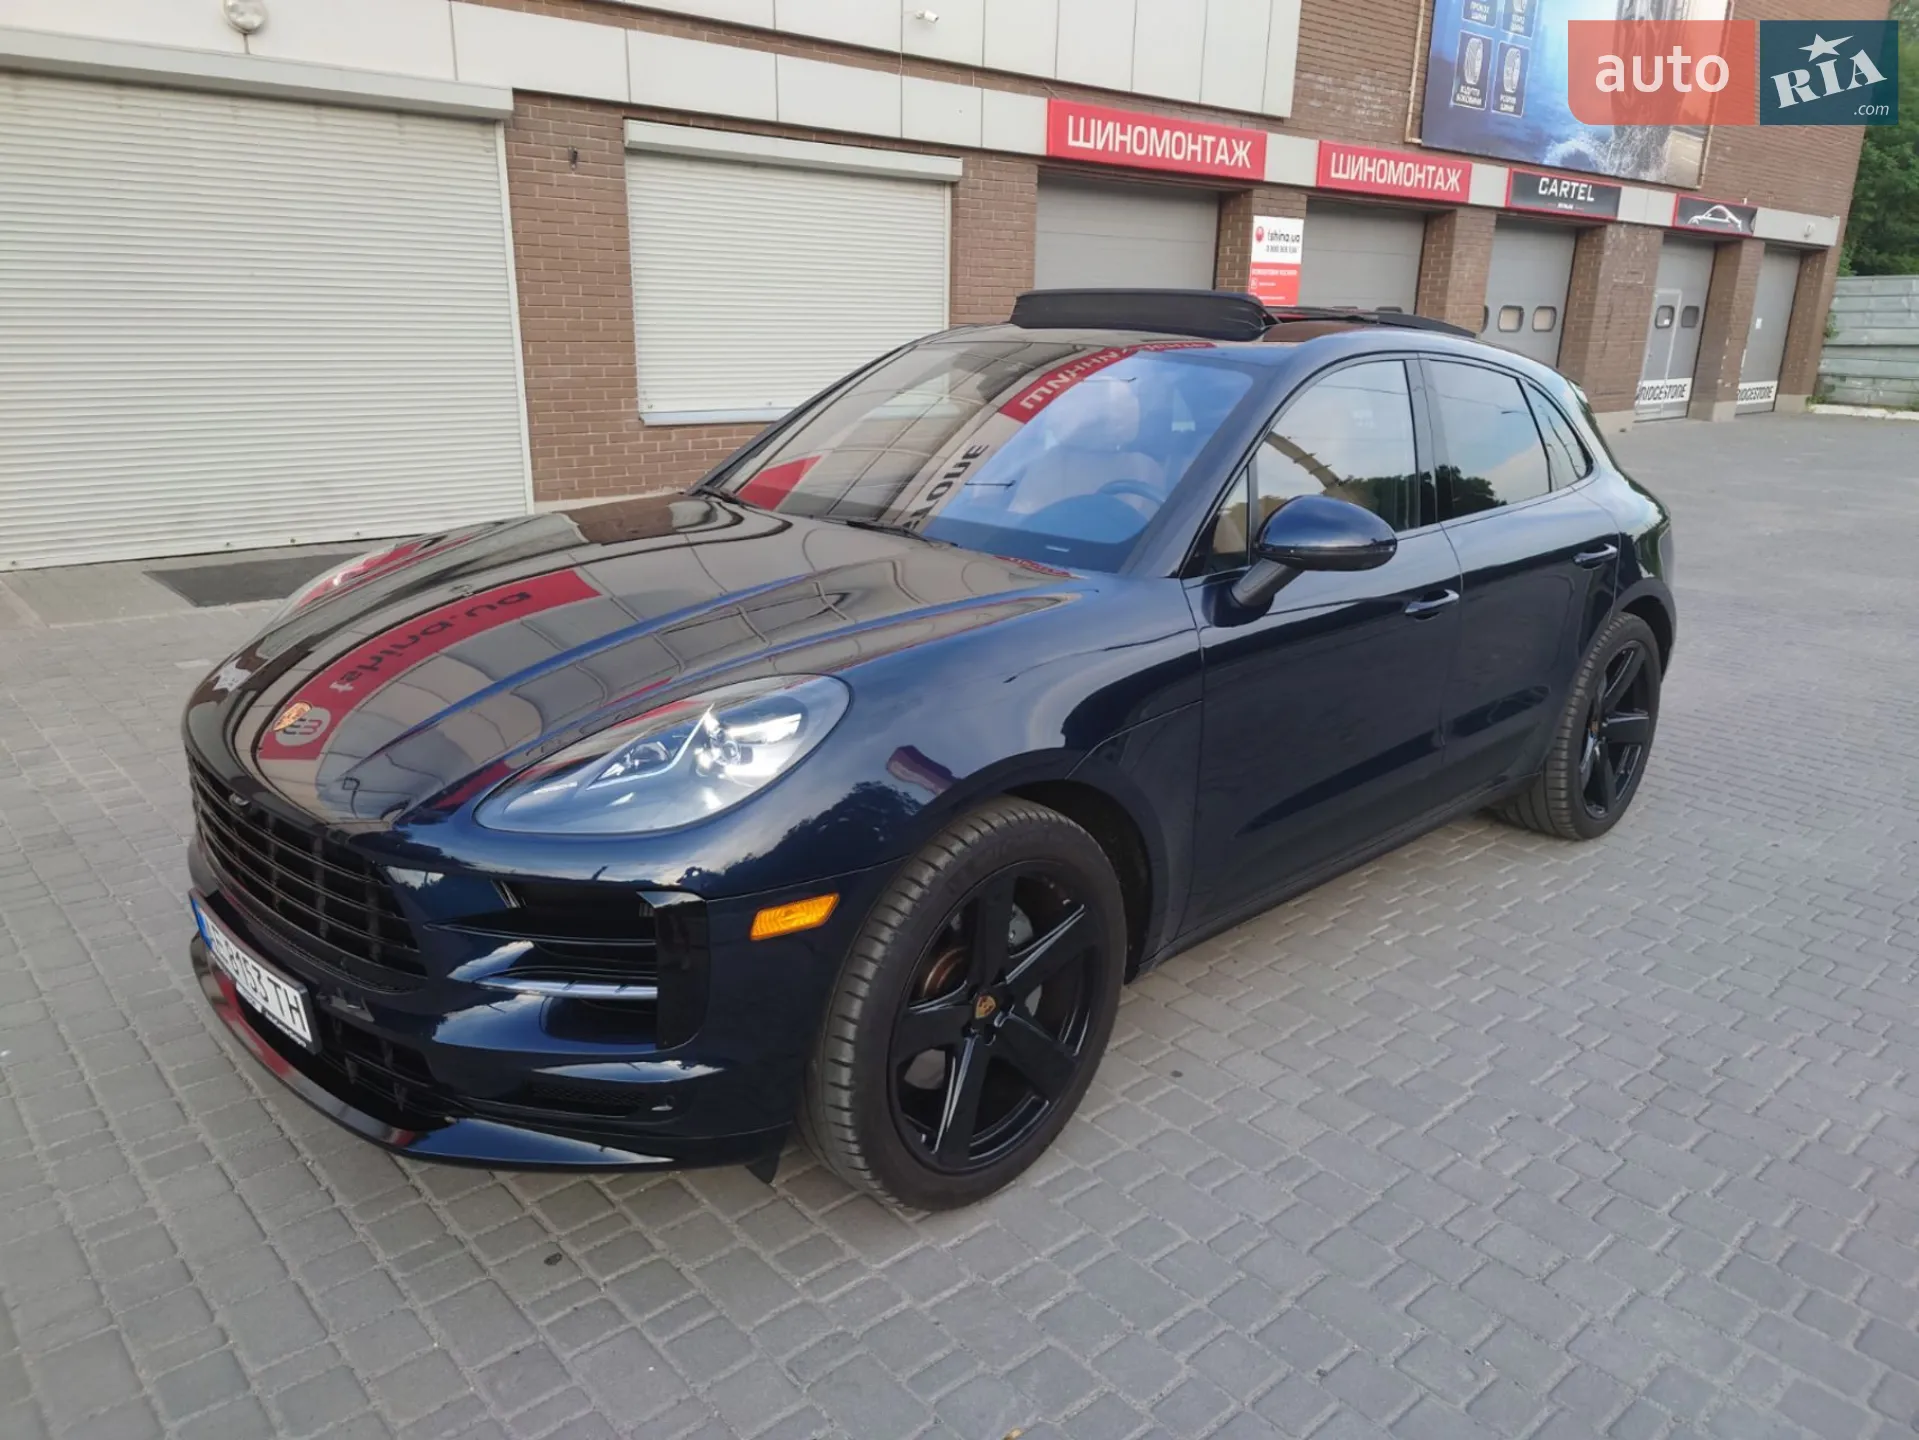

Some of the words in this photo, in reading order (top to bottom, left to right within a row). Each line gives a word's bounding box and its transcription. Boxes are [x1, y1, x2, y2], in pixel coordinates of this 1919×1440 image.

[1067, 115, 1252, 169] ШИНОМОНТАЖ
[1330, 152, 1462, 193] ШИНОМОНТАЖ
[1538, 177, 1595, 202] CARTEL
[267, 975, 307, 1033] TH
